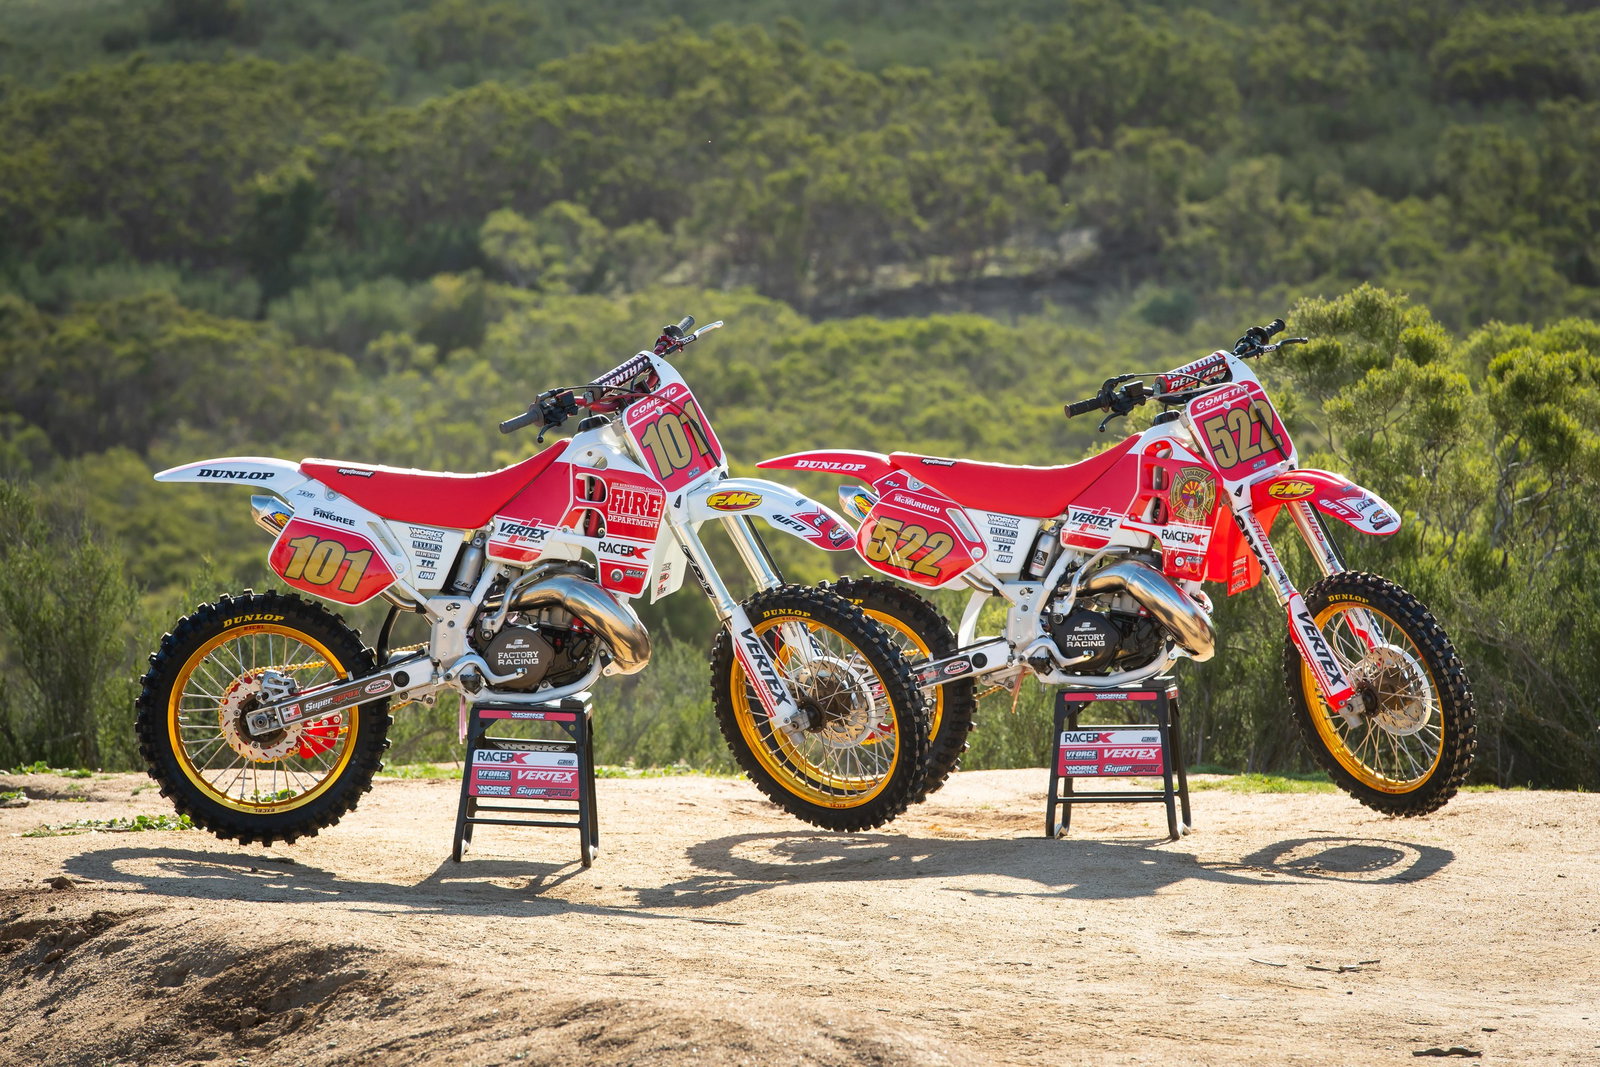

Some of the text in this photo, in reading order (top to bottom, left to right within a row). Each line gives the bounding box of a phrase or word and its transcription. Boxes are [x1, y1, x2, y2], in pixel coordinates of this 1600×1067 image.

[602, 359, 648, 392] RENTHA
[641, 398, 710, 481] 101
[1203, 399, 1284, 469] 522
[794, 459, 867, 472] DUNLOP
[197, 468, 275, 481] DUNLOP
[1269, 482, 1316, 496] FMF
[608, 488, 662, 519] FIRE
[707, 493, 762, 507] FMF
[894, 496, 940, 514] McMURRICH
[313, 510, 355, 526] PINGREE
[607, 515, 660, 528] DEPARTMENT
[1071, 511, 1117, 528] VERTEX
[500, 522, 550, 540] VERTEX
[866, 515, 954, 578] 522
[998, 544, 1011, 552] TM
[284, 534, 373, 594] 101
[421, 559, 435, 567] TM
[1328, 594, 1370, 603] DUNLOP
[763, 608, 812, 618] DUNLOP
[223, 613, 285, 628] DUNLOP
[1066, 633, 1105, 641] FACTORY
[498, 651, 539, 659] FACTORY
[1297, 611, 1347, 687] VERTEX
[741, 628, 792, 706] VERTEX
[497, 742, 569, 752] WORKS
[1103, 748, 1159, 758] VERTEX
[517, 770, 576, 781] VERTEX
